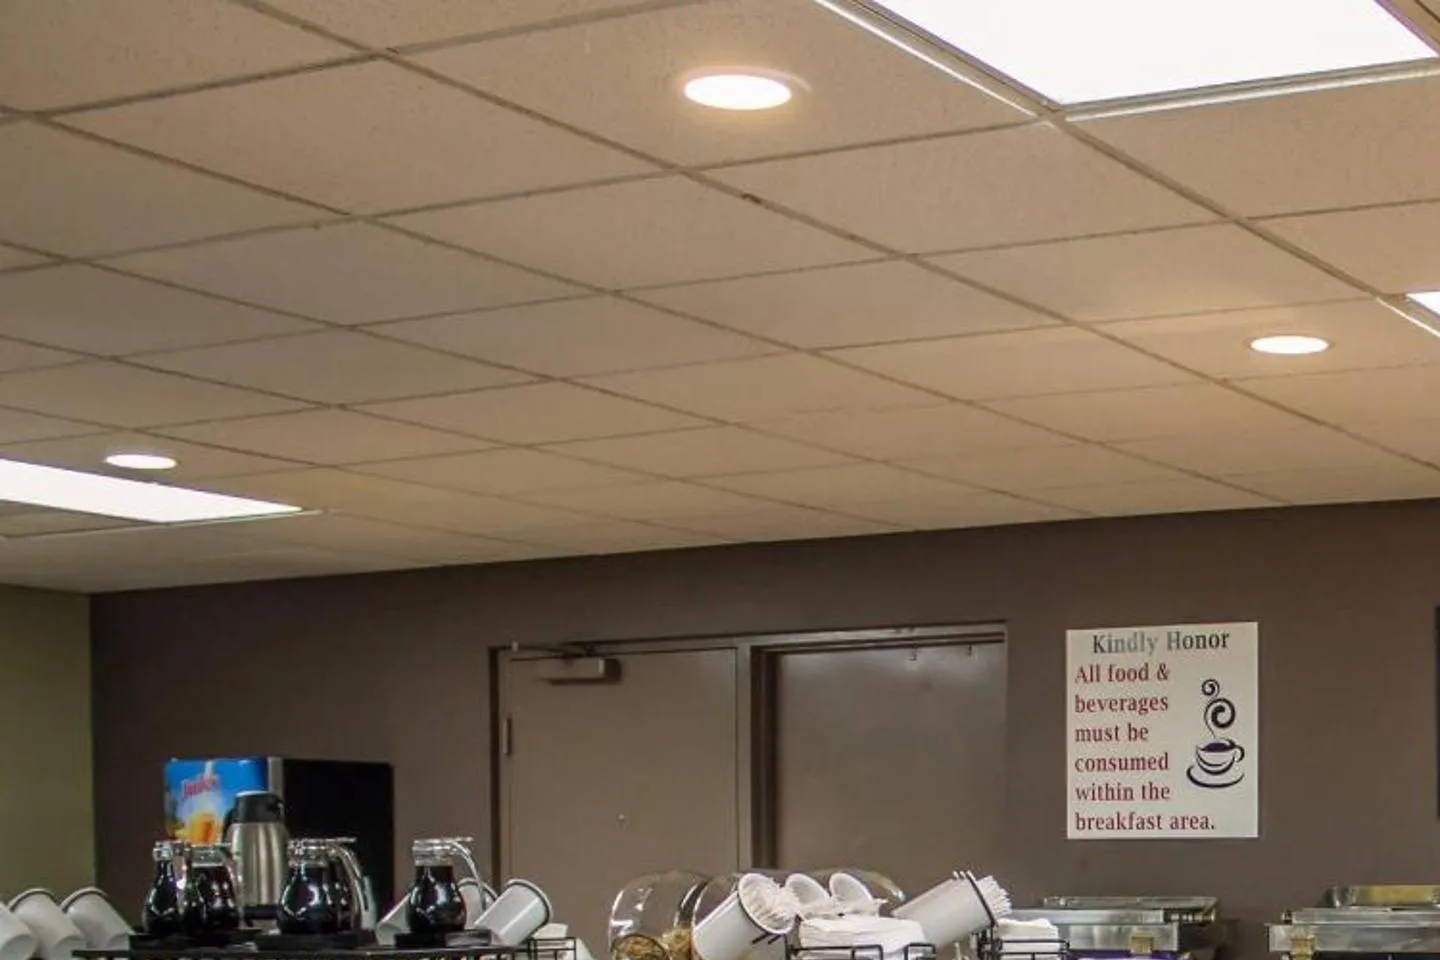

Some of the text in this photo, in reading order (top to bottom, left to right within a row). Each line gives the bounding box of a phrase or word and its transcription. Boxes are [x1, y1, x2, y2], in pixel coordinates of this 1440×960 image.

[1092, 630, 1230, 656] Kindly Honor
[1075, 661, 1170, 683] All food &
[1074, 694, 1169, 715] beverages
[1074, 723, 1149, 743] must be
[1074, 752, 1169, 773] consumed
[1074, 782, 1170, 801] within the
[1074, 811, 1215, 831] breakfast area.
